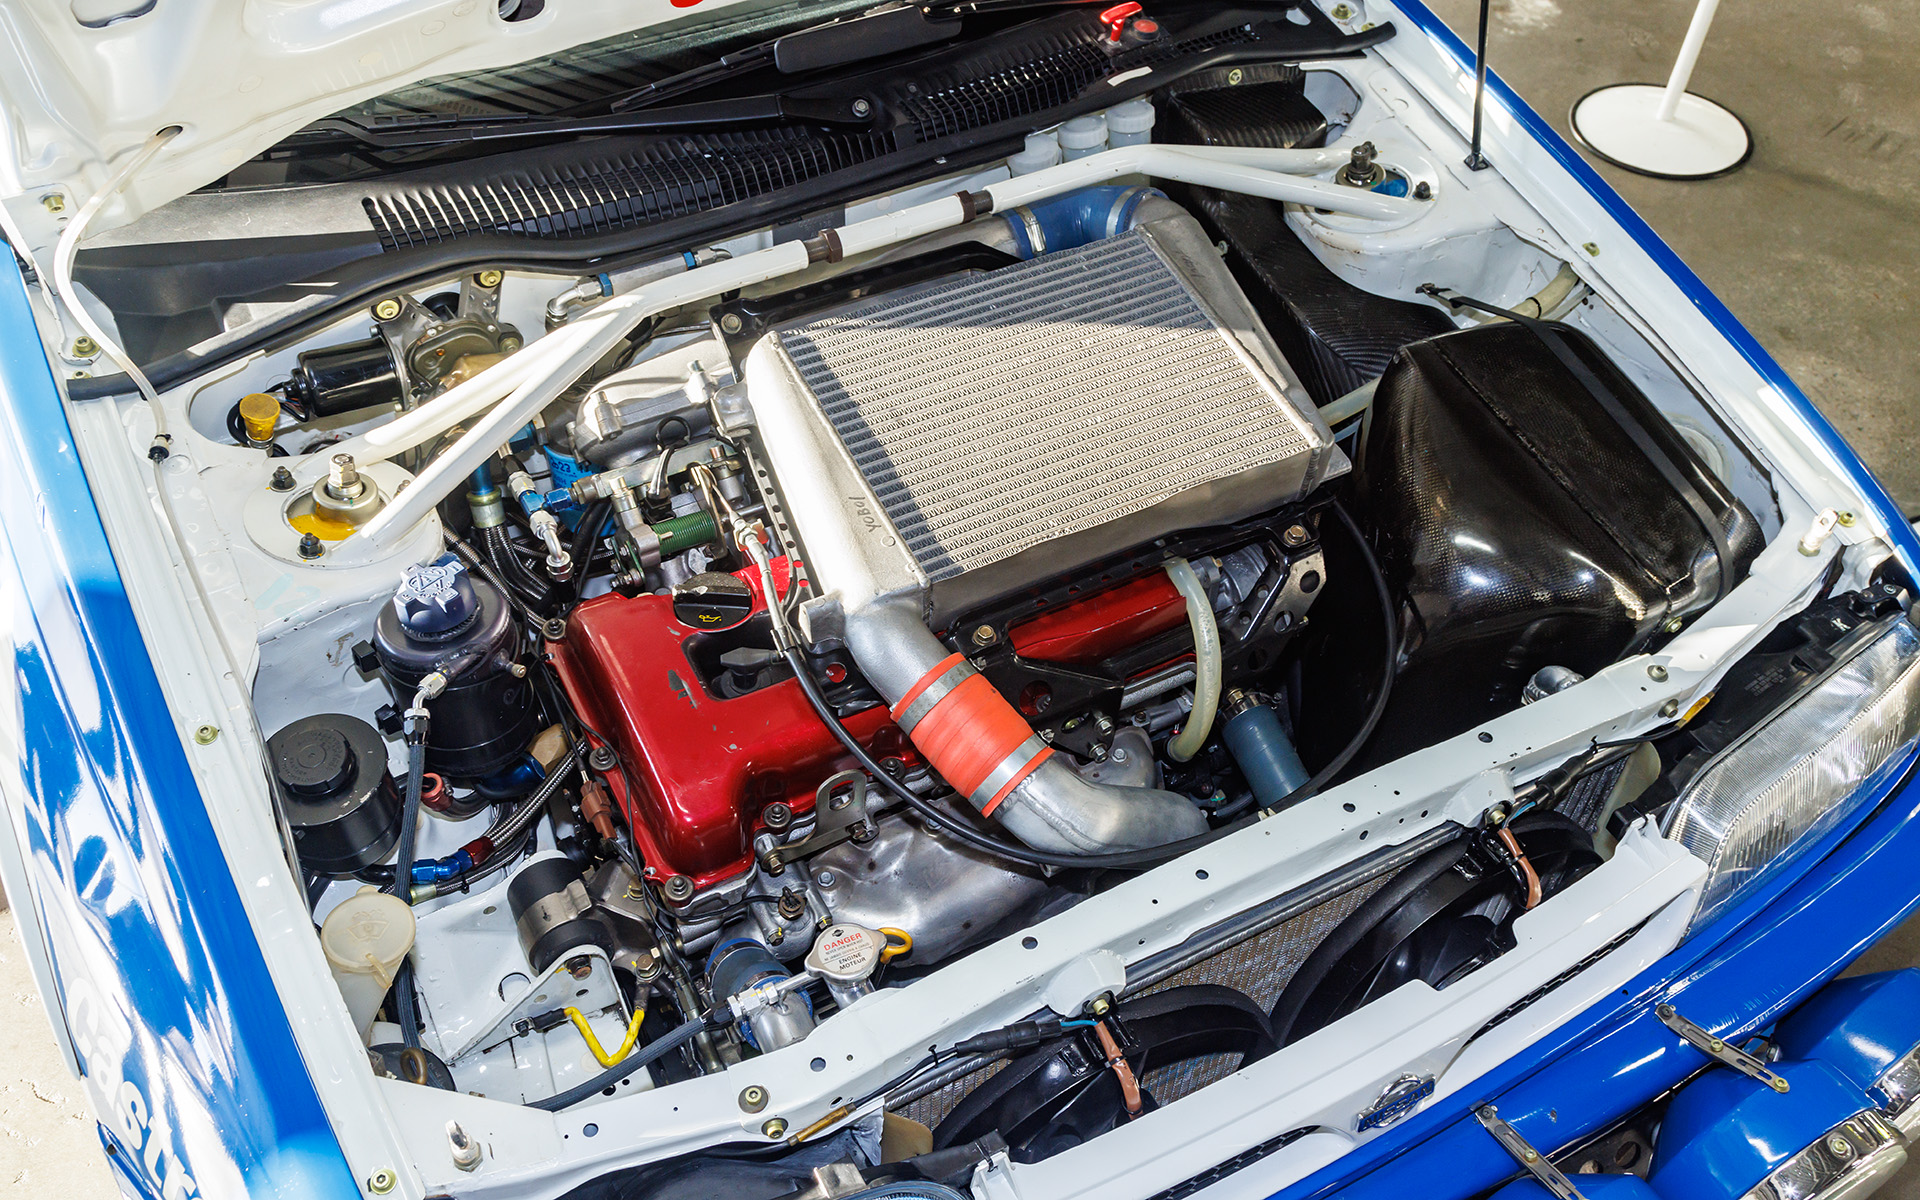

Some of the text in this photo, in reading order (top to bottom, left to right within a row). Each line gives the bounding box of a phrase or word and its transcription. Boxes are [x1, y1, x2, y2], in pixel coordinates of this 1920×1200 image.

[823, 932, 863, 951] DANGER
[838, 952, 862, 964] ENGINE
[839, 957, 867, 970] MOTEUR
[67, 977, 203, 1200] Castr
[1361, 1082, 1433, 1129] NISSAN
